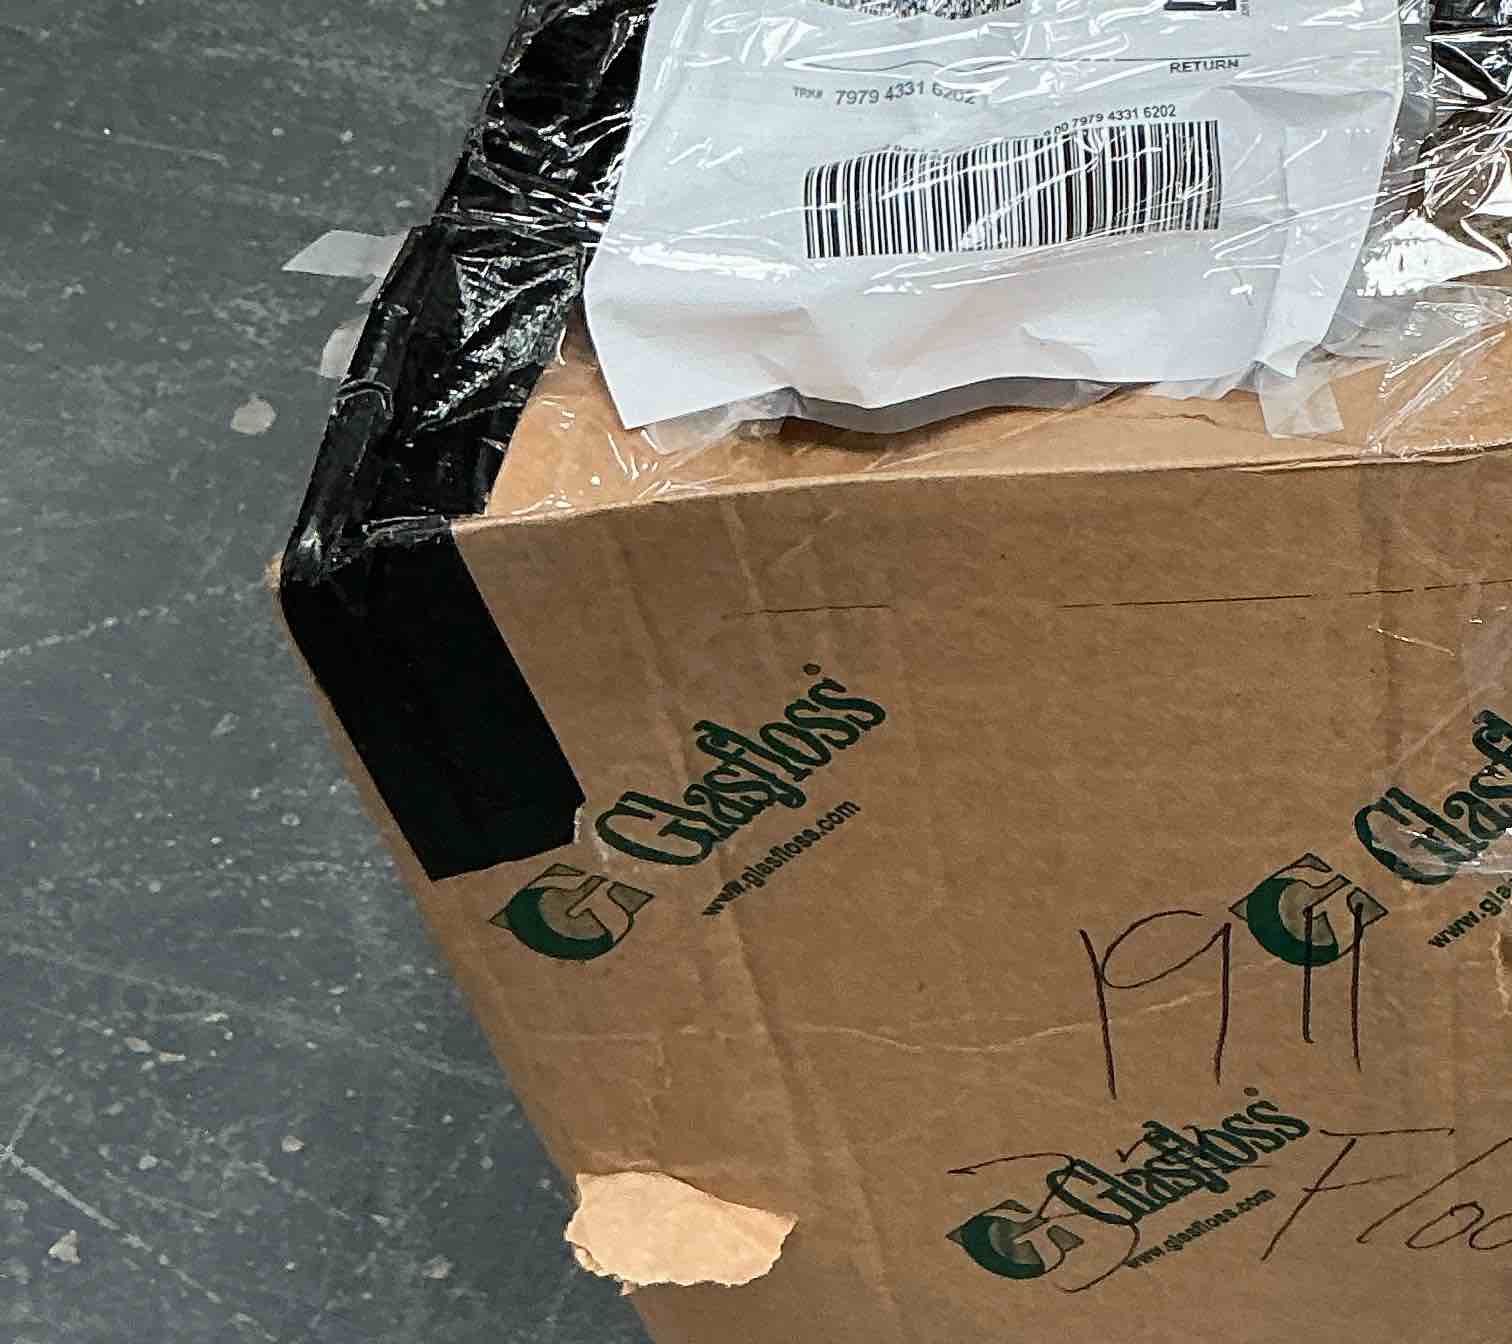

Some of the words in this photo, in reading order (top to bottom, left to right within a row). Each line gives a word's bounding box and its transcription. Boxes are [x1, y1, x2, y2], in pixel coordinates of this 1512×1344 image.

[834, 89, 880, 106] 7979
[884, 80, 926, 102] 4331
[1169, 58, 1240, 74] RETURN
[1072, 112, 1104, 129] 7979
[1107, 106, 1139, 122] 4331
[1143, 104, 1177, 119] 6202
[594, 677, 887, 867] Glasfloss
[701, 799, 862, 917] www.glasfloss.com
[1046, 1100, 1311, 1225] Glasfloss
